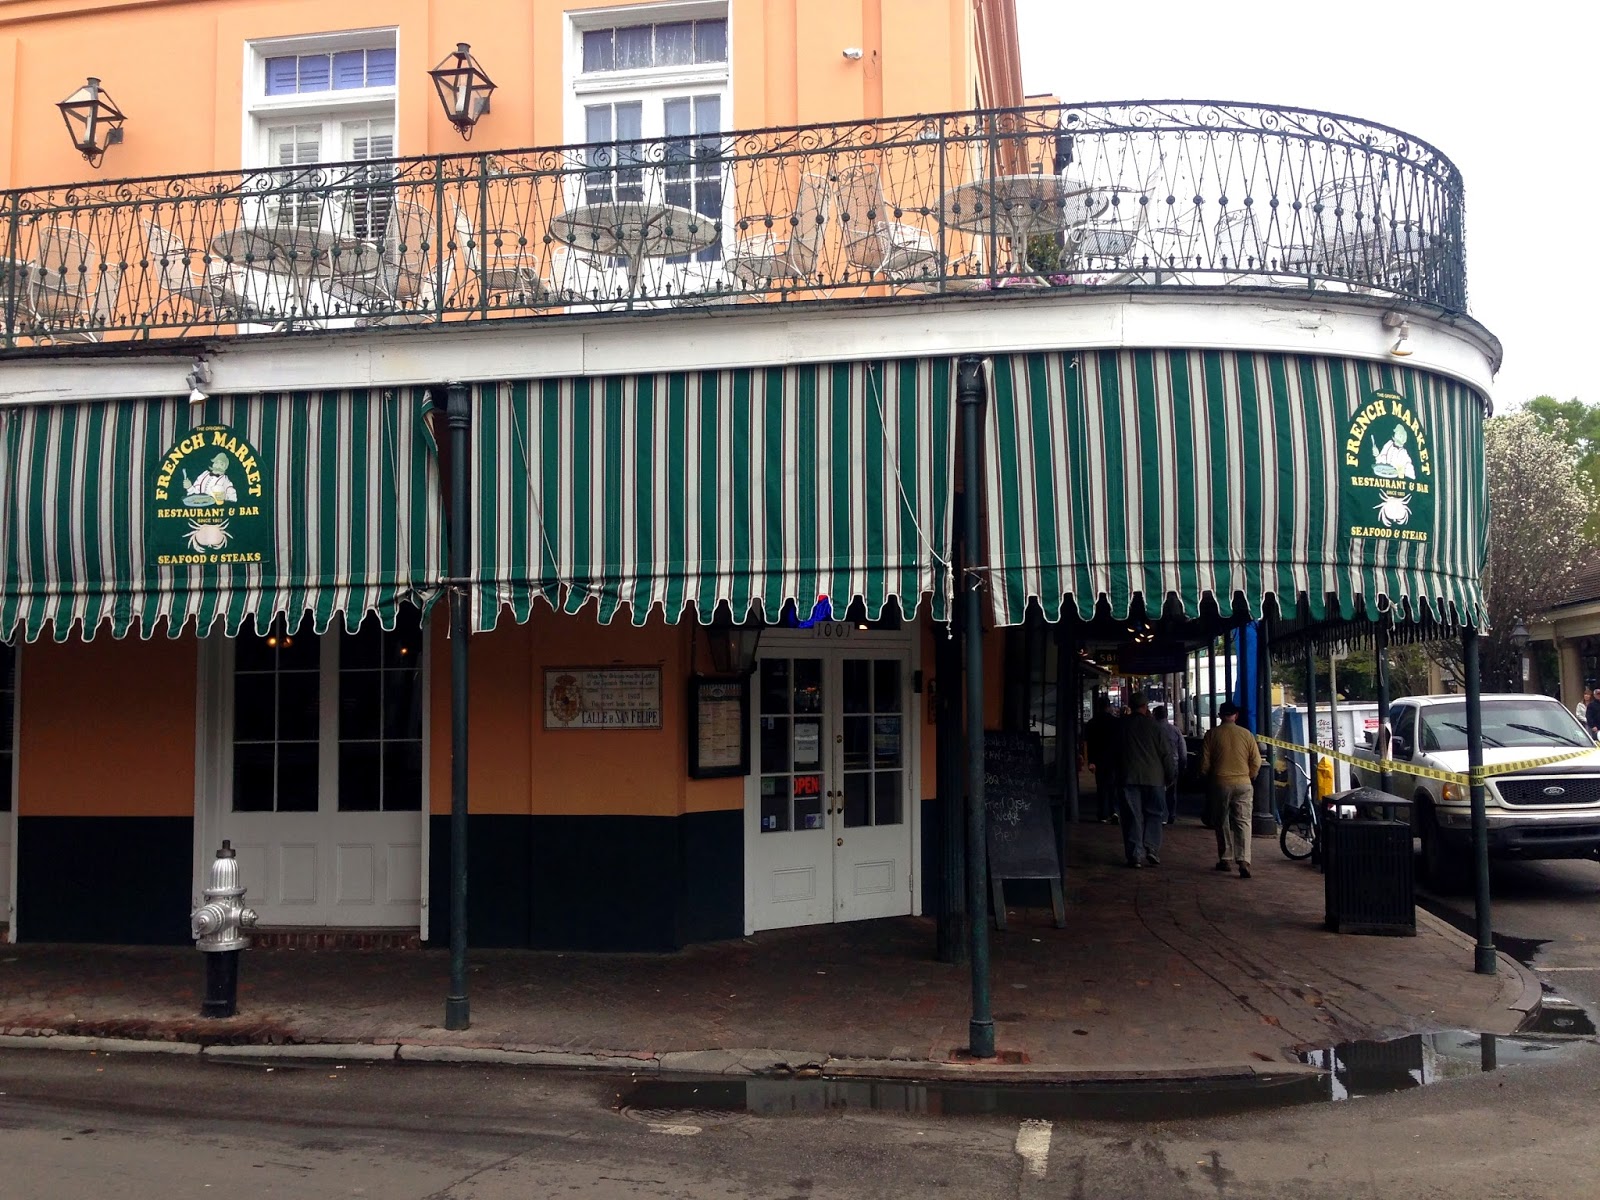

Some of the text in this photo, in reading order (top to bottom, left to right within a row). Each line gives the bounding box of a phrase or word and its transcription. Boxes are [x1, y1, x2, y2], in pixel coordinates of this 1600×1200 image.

[1346, 400, 1431, 476] FRENCH MARKET
[155, 431, 262, 500] FRENCH MARKET
[1351, 476, 1429, 494] RESTAURANT & BAR
[157, 506, 260, 518] RESTAURANT & BAR
[1350, 526, 1428, 541] SEAFOOD & STEAKS
[157, 552, 261, 564] SEAFOOD & STEAKS
[1100, 653, 1117, 662] SBI
[582, 710, 608, 724] CALLE
[615, 709, 629, 724] SAN
[631, 709, 658, 724] FELIPE
[794, 776, 819, 795] OPEN
